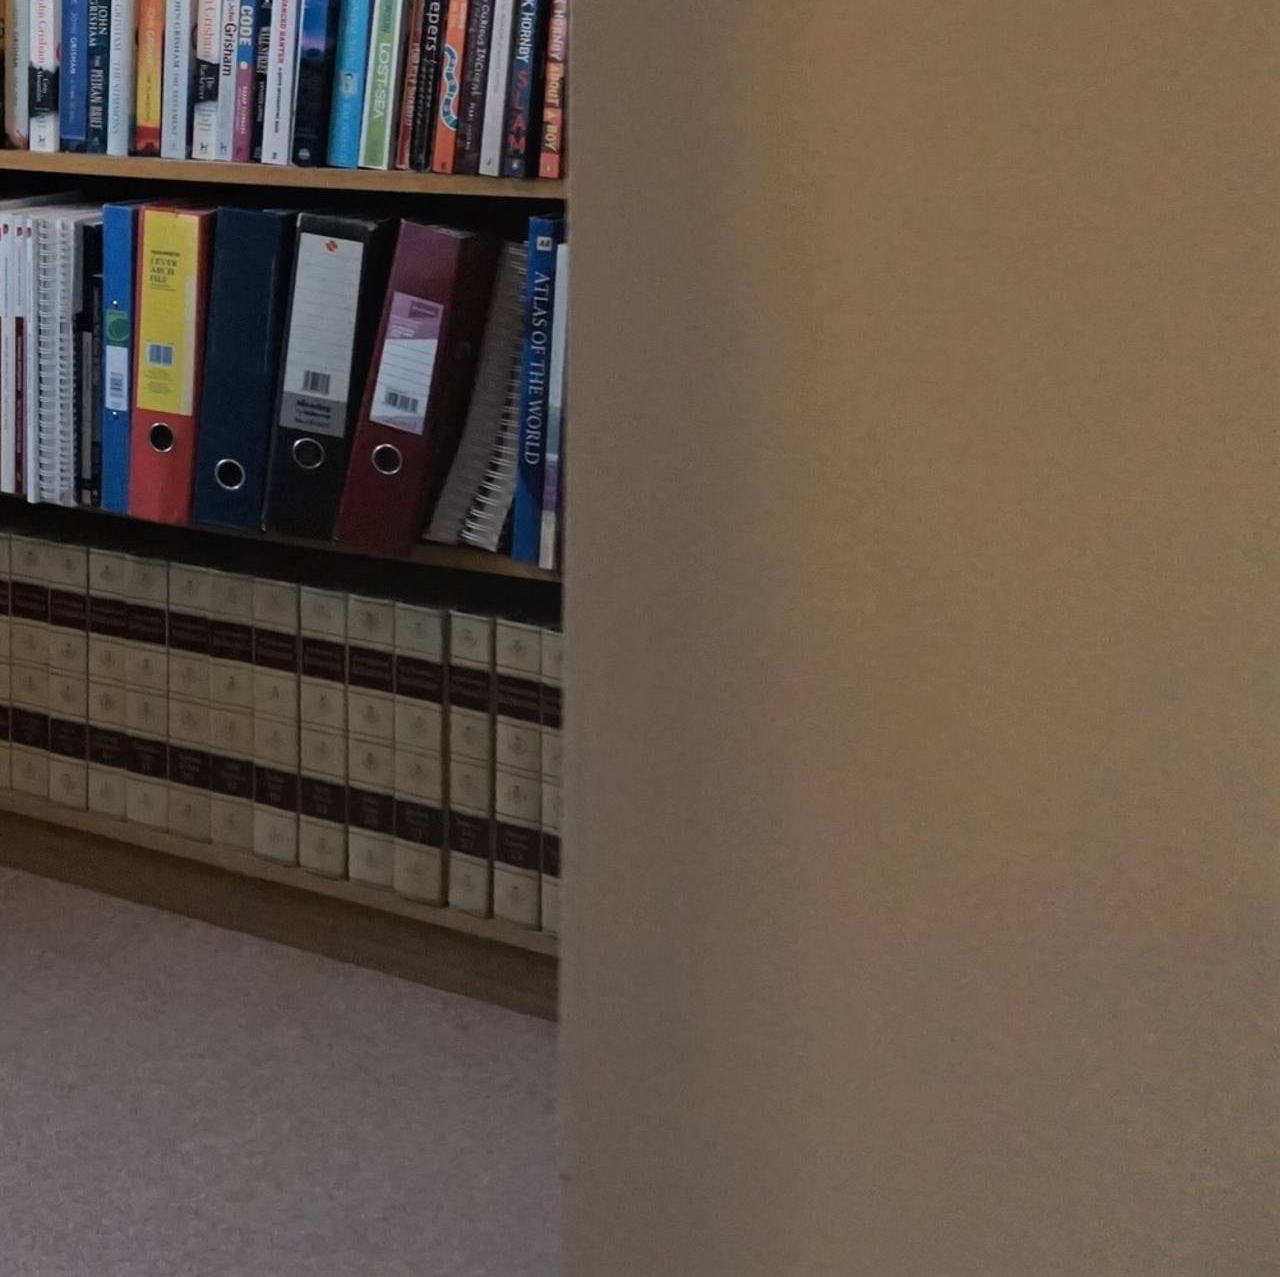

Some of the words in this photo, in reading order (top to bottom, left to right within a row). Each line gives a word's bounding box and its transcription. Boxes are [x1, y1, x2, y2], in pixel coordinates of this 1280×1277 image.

[37, 18, 48, 64] Grisham
[99, 5, 109, 36] JOHN
[202, 6, 217, 59] Grisham
[240, 4, 253, 46] CODE
[515, 11, 534, 64] HORNBY
[549, 8, 566, 61] HORNBY
[70, 36, 78, 75] GRISHAM
[172, 22, 182, 69] GRISHAM
[222, 22, 237, 77] Grisham
[377, 43, 391, 86] LOST
[373, 89, 387, 120] SEA
[546, 63, 563, 108] ABOUT
[544, 123, 559, 151] BOY
[546, 110, 560, 120] A
[531, 270, 551, 328] ATLAS
[530, 330, 549, 355] OF
[528, 358, 546, 395] THE
[524, 400, 544, 466] WORLD
